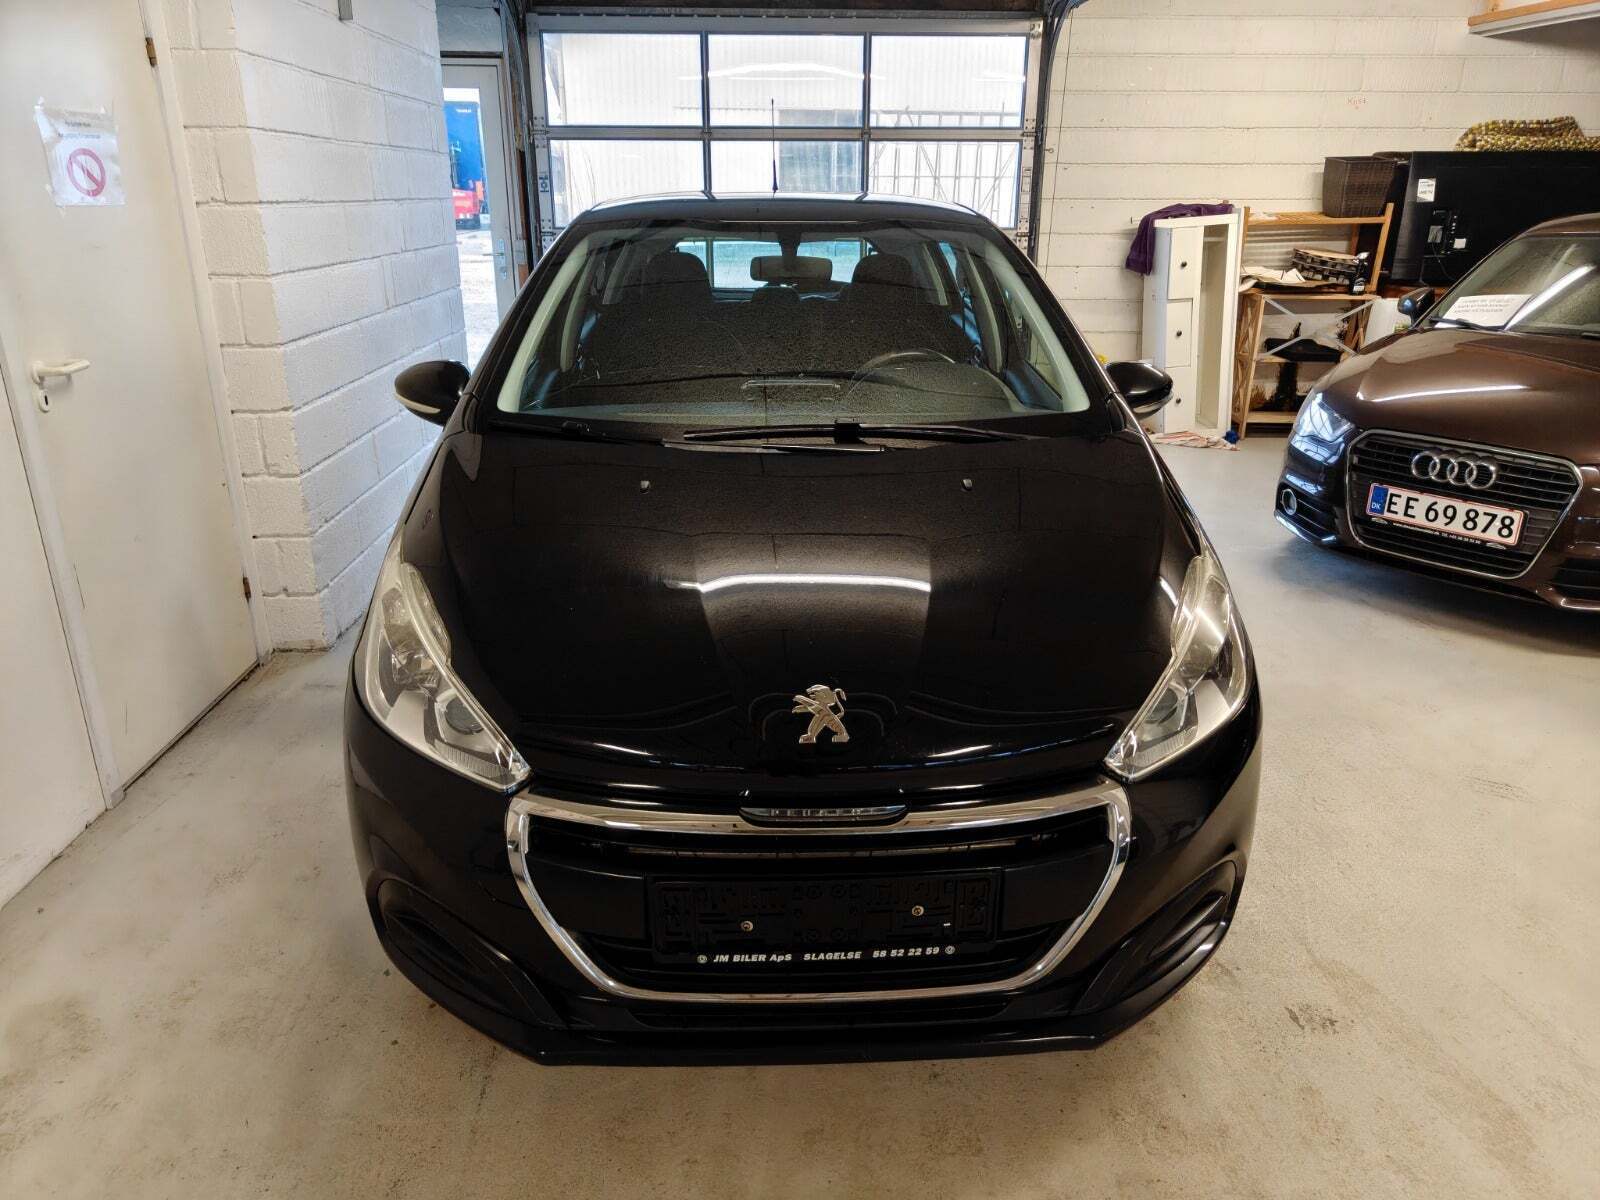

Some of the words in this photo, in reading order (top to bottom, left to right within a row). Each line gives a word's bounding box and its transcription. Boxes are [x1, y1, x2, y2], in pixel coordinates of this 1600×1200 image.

[1371, 502, 1381, 510] DK
[1386, 493, 1419, 519] EE
[1425, 501, 1458, 526] 69
[1462, 508, 1515, 539] 878
[713, 954, 729, 963] JM
[732, 954, 767, 963] BILER
[769, 953, 792, 963] ApS
[803, 951, 862, 961] SLAGELSE
[890, 948, 905, 957] 52
[908, 947, 923, 957] 22
[925, 946, 940, 956] 59
